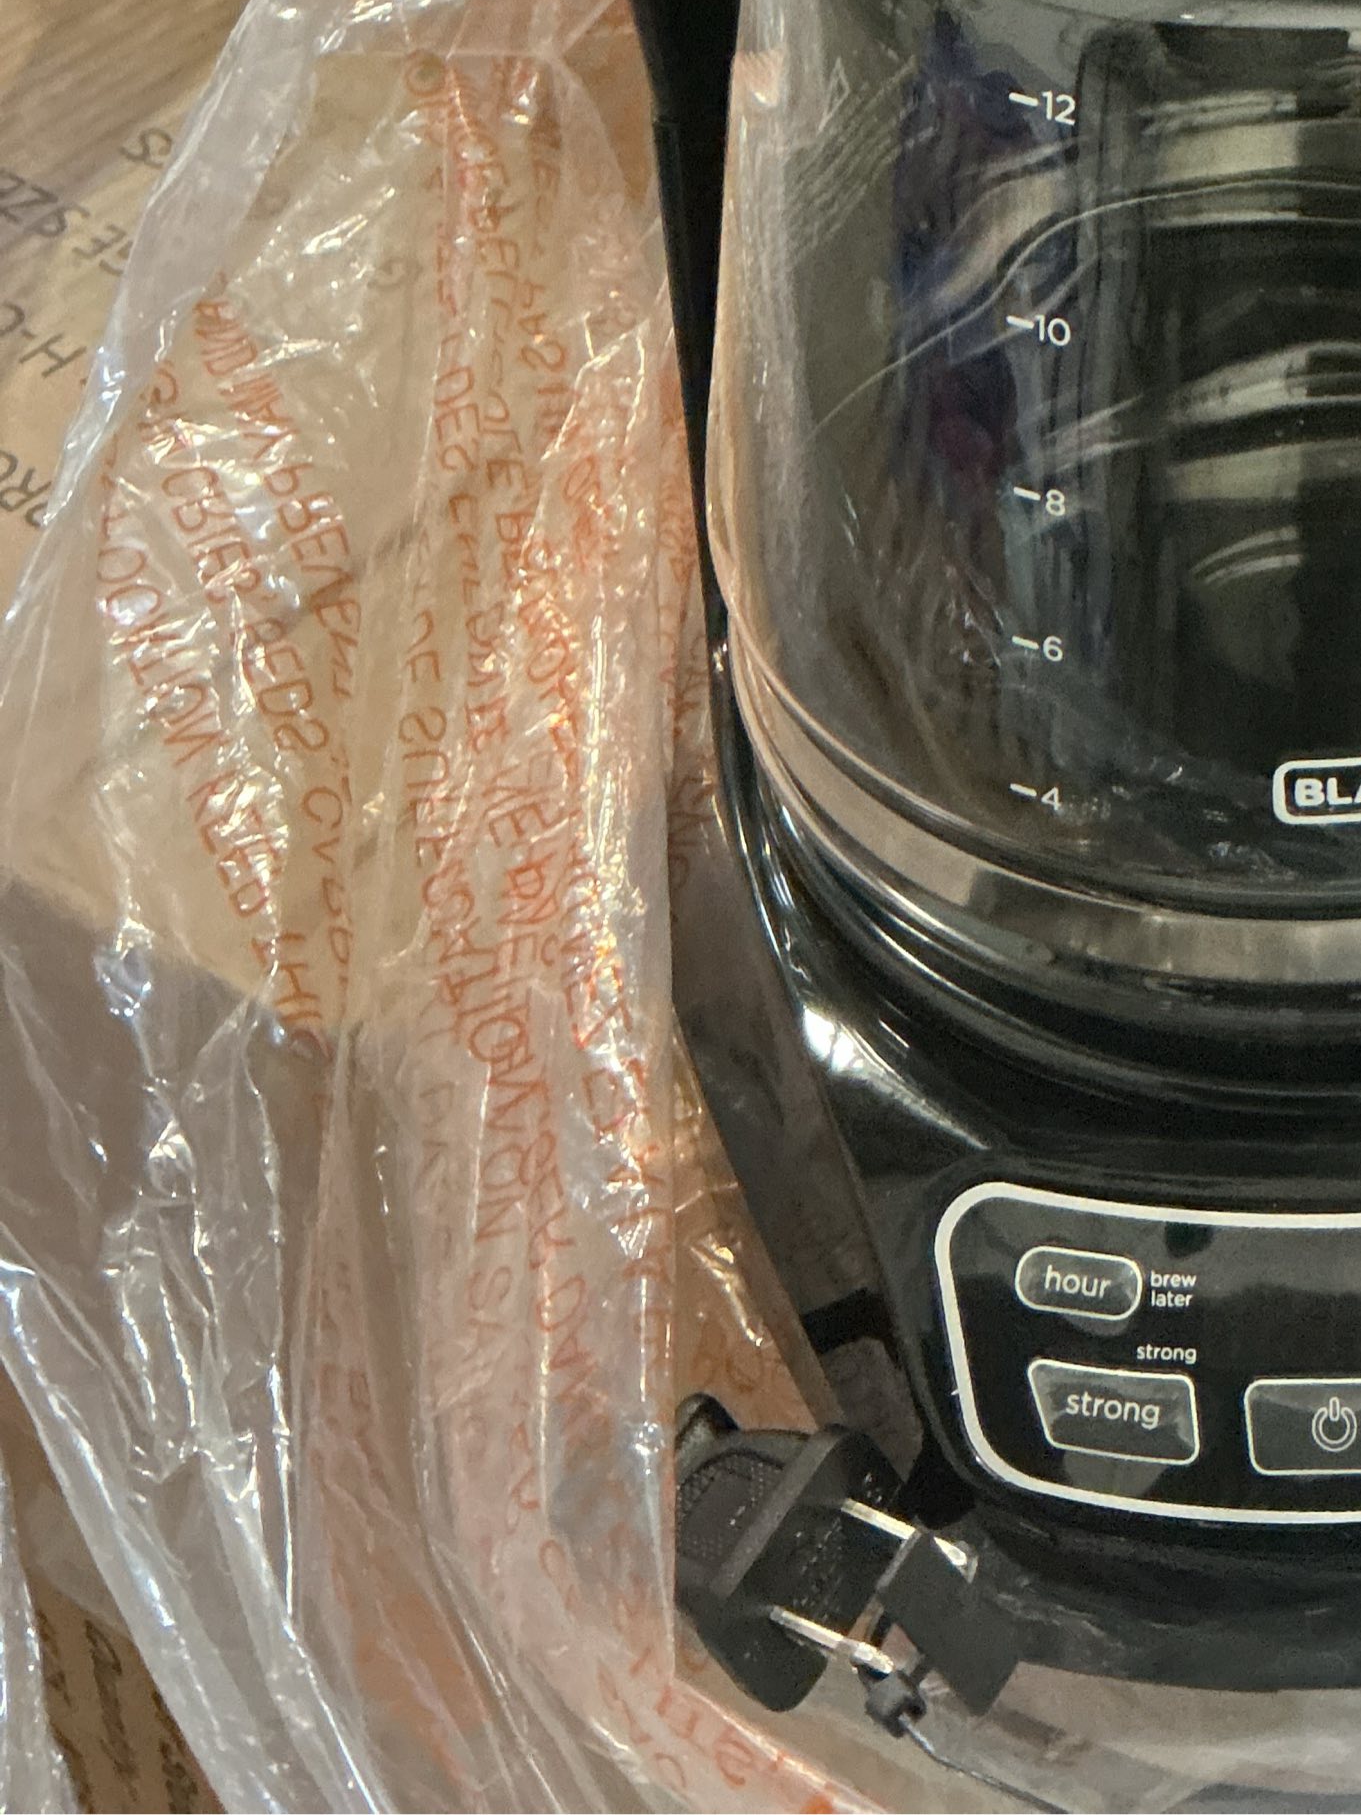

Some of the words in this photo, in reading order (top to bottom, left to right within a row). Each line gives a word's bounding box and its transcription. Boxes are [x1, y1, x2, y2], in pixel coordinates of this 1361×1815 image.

[1046, 489, 1066, 517] 8
[1042, 636, 1064, 662] 6
[1041, 786, 1061, 811] 4
[1044, 1264, 1112, 1299] hour
[1150, 1270, 1197, 1288] brew
[1151, 1289, 1193, 1308] later
[1137, 1343, 1197, 1365] strong
[1065, 1390, 1161, 1430] strong
